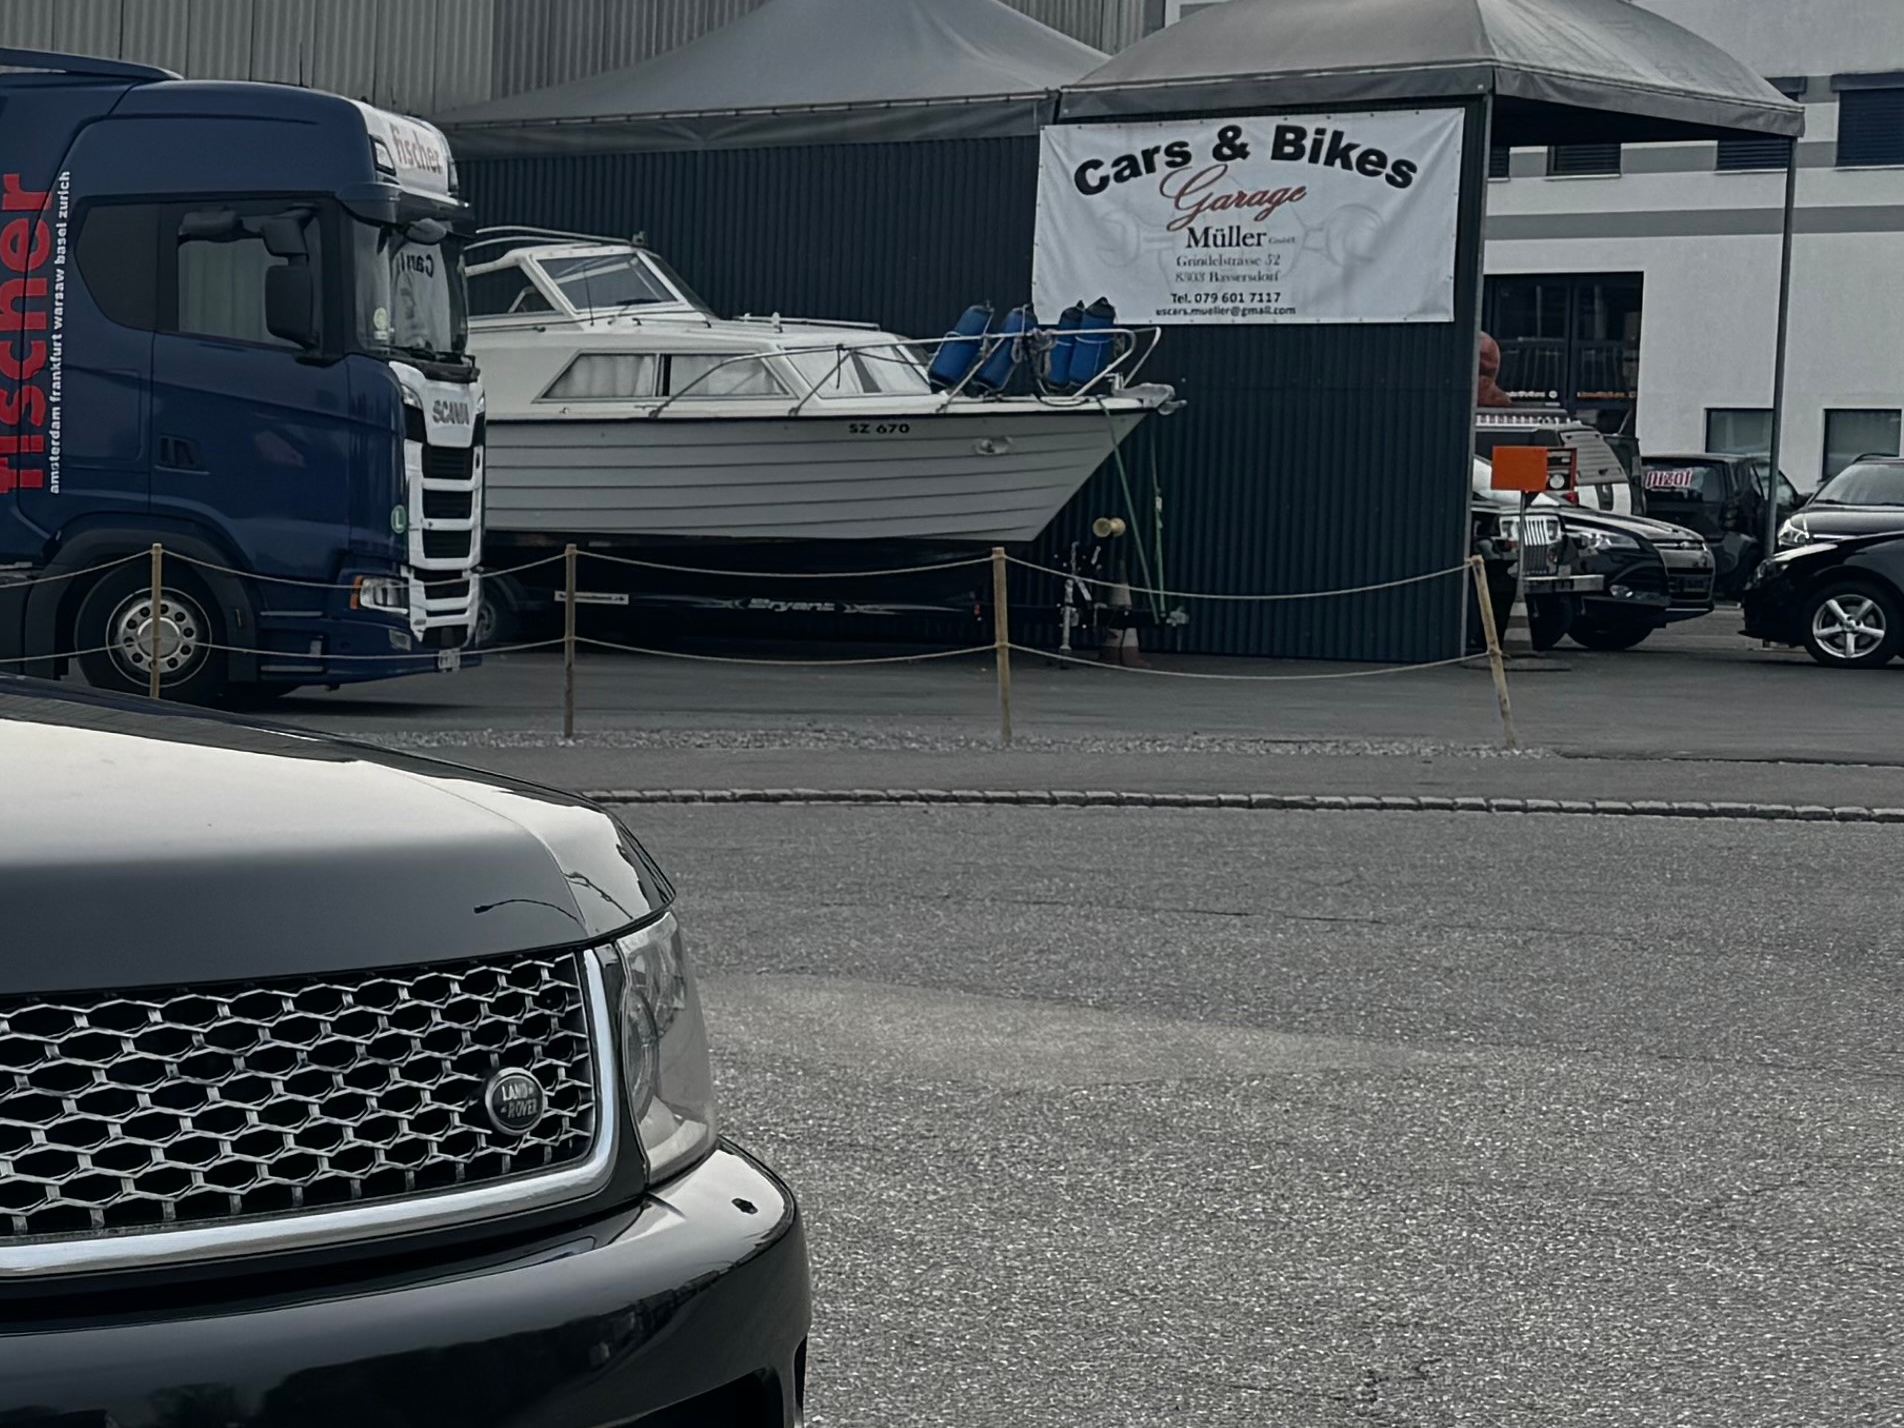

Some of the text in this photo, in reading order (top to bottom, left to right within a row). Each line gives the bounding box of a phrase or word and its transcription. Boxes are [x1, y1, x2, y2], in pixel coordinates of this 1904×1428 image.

[390, 123, 442, 174] fischer
[1074, 125, 1418, 195] Cars & Bikes
[1159, 164, 1307, 231] Garage
[1186, 226, 1267, 248] Müller
[1170, 292, 1281, 304] Tel. 079 601 7117
[49, 171, 71, 494] amsterdam frankfurt warsaw basel zurich
[432, 399, 470, 425] SCANIA
[849, 423, 910, 434] SZ 670
[395, 509, 402, 529] L
[502, 1083, 528, 1101] LAND
[508, 1099, 537, 1118] ROVER
